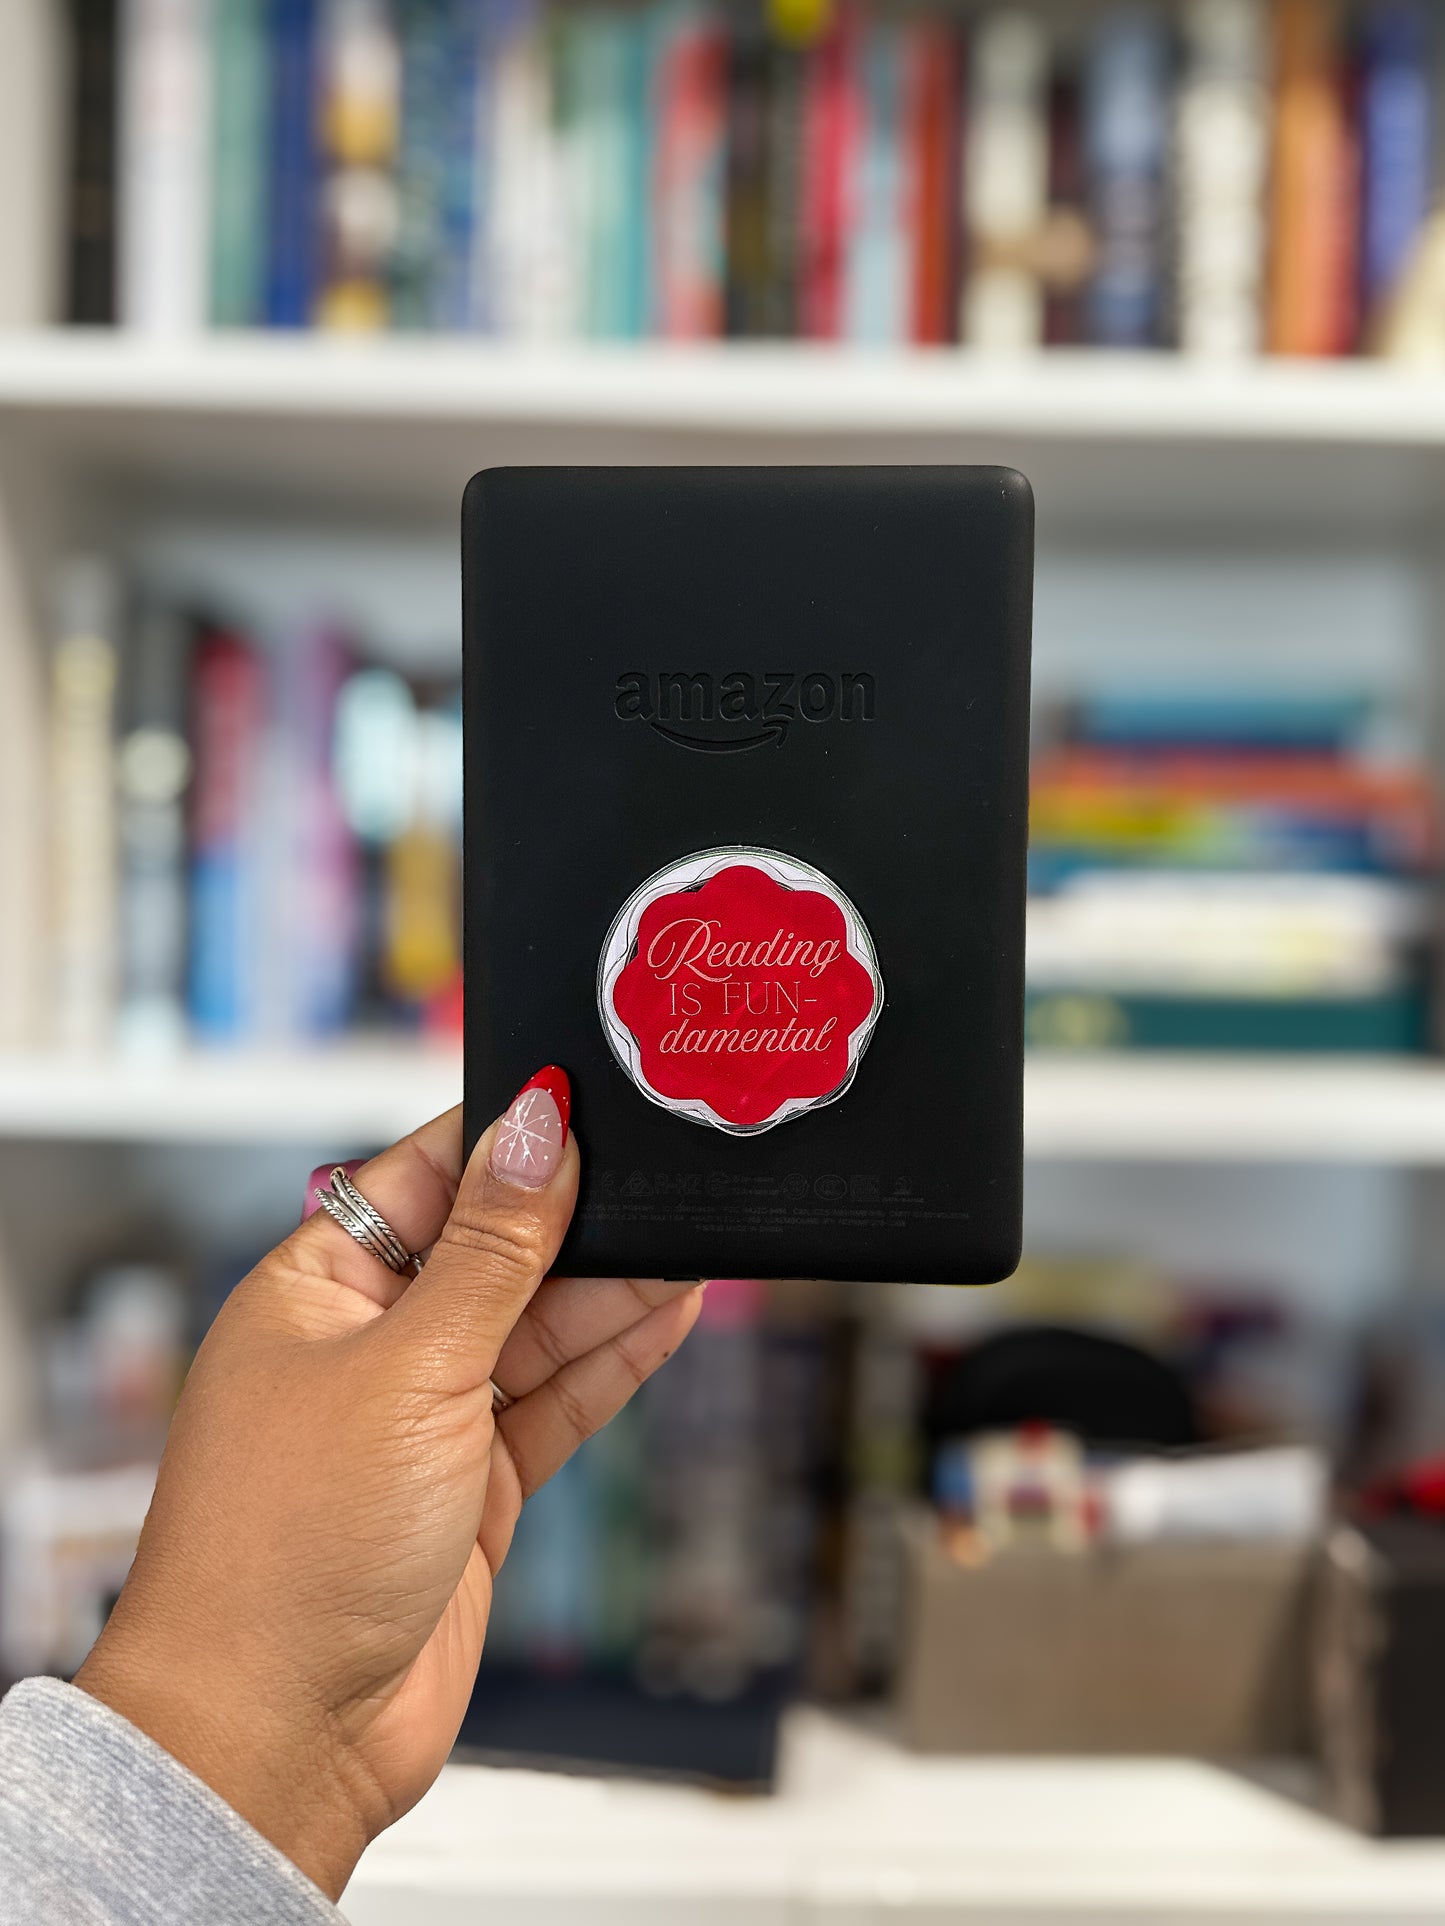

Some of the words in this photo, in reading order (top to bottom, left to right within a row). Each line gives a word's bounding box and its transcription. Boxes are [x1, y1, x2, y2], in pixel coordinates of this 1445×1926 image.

[614, 672, 875, 723] amazon
[647, 918, 841, 982] Reading
[669, 982, 702, 1016] IS
[722, 981, 818, 1015] FUN-
[659, 1016, 838, 1053] damental
